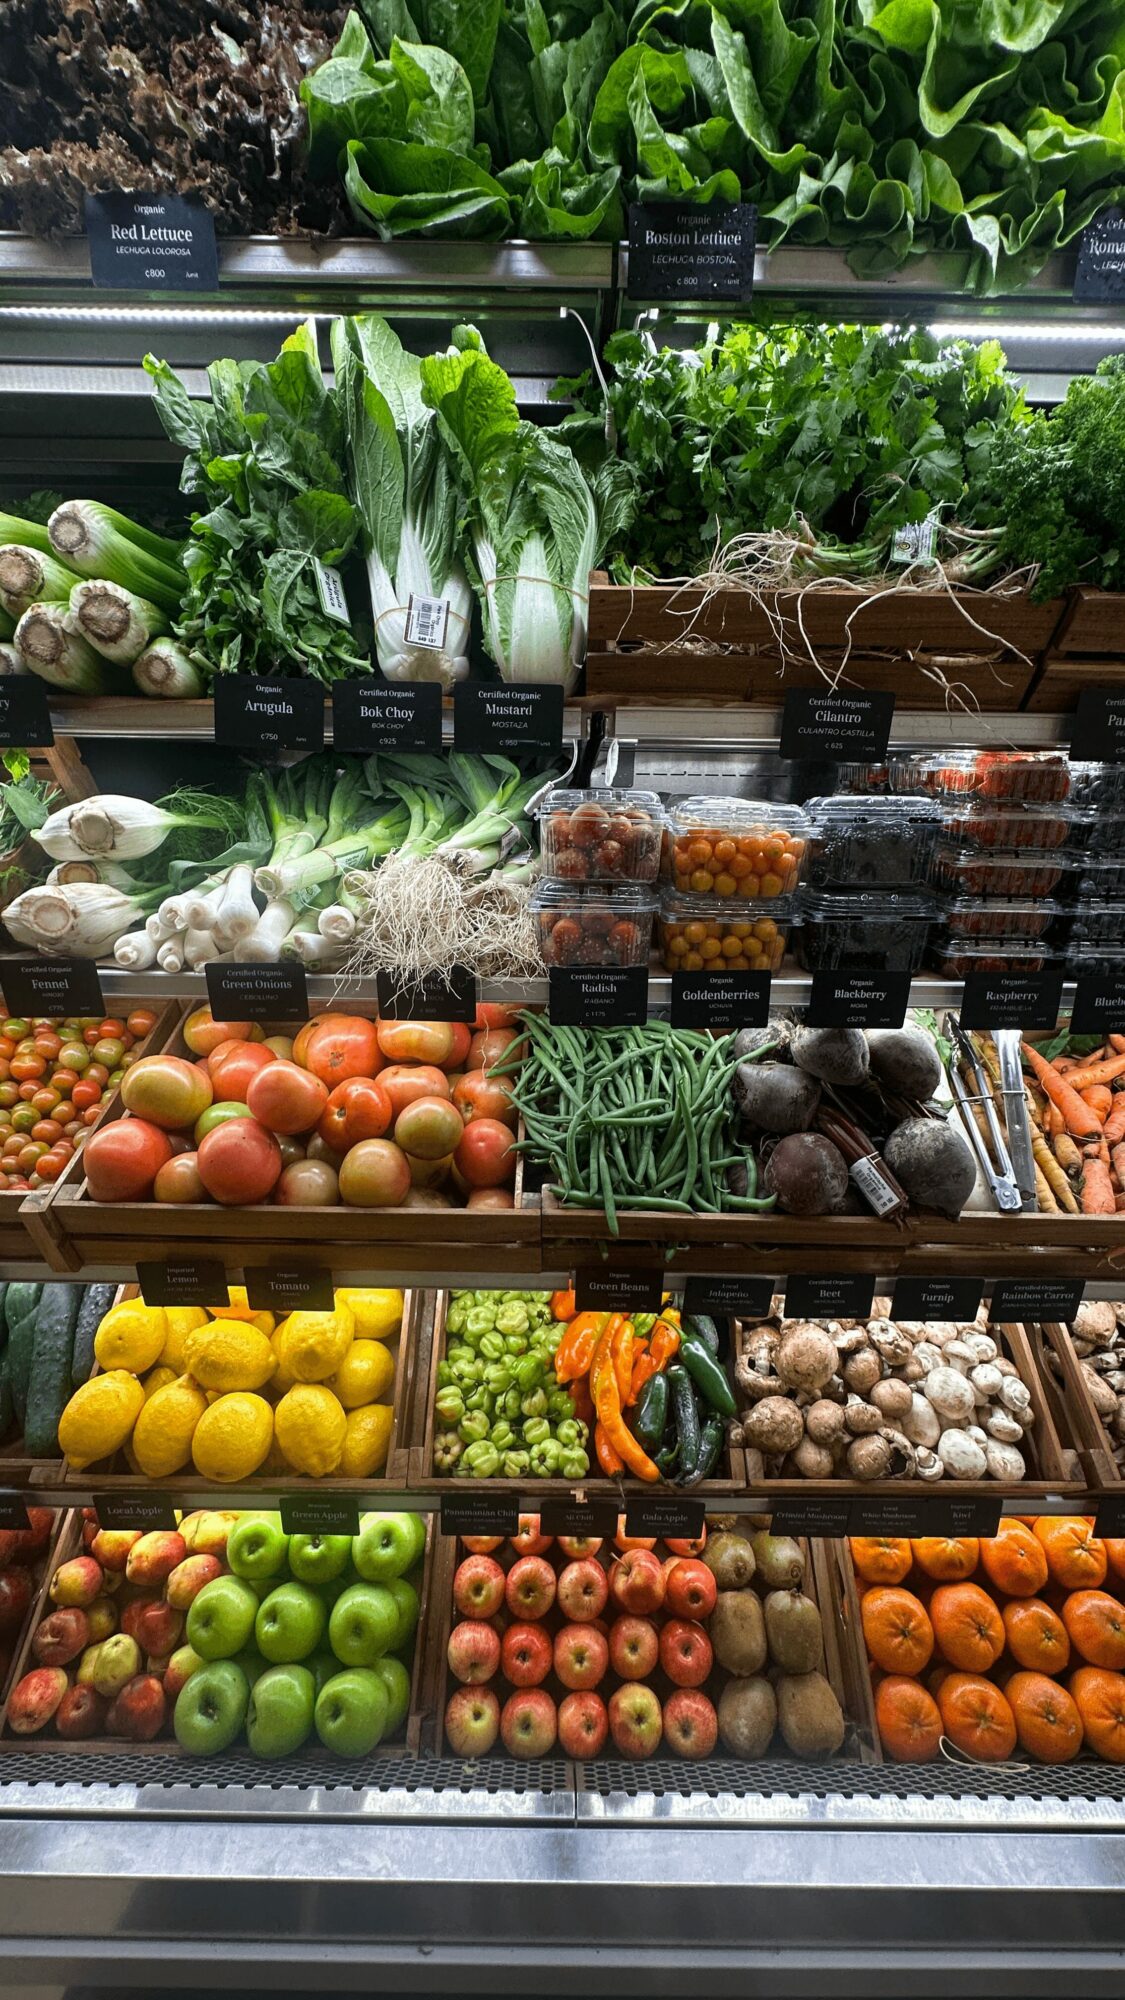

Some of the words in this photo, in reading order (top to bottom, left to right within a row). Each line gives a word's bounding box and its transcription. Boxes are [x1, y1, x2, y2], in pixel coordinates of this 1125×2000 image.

[134, 204, 165, 215] Organic
[111, 224, 138, 240] Red
[141, 225, 193, 241] Lettuce
[645, 230, 690, 245] Boston
[694, 230, 742, 245] Lettuce
[116, 246, 151, 254] LECHUGA
[152, 247, 191, 256] LOLOROSA
[652, 255, 694, 264] LECHUGA
[697, 256, 734, 265] BOSTON
[255, 684, 283, 694] Organic
[359, 689, 388, 697] Certified
[388, 690, 416, 699] Organic
[478, 690, 510, 699] Certified
[511, 691, 542, 701] Organic
[244, 700, 294, 716] Arugula
[808, 697, 840, 707] Certified
[841, 699, 872, 709] Organic
[360, 705, 383, 718] Bok
[385, 706, 416, 722] Choy
[485, 703, 533, 716] Mustard
[815, 710, 862, 723] Cilantro
[491, 721, 529, 729] MOSTAZA
[798, 726, 840, 735] CULANTRO
[840, 729, 875, 737] CASTILLA
[31, 979, 70, 989] Fennel
[222, 979, 253, 989] Green
[255, 979, 292, 989] Onions
[581, 983, 617, 993] Radish
[682, 989, 760, 1000] Goldenberries
[834, 989, 887, 1001] Blackberry
[986, 991, 1039, 1003] Raspberry
[166, 1275, 198, 1284] Lemon
[268, 1281, 311, 1291] Tomato
[589, 1282, 618, 1291] Green
[620, 1282, 650, 1292] Beans
[820, 1289, 841, 1298] Beet
[920, 1293, 955, 1303] Turnip
[1001, 1292, 1041, 1300] Rainbow
[1043, 1292, 1075, 1300] Carrot
[106, 1506, 134, 1515] Local
[134, 1506, 164, 1516] Apple
